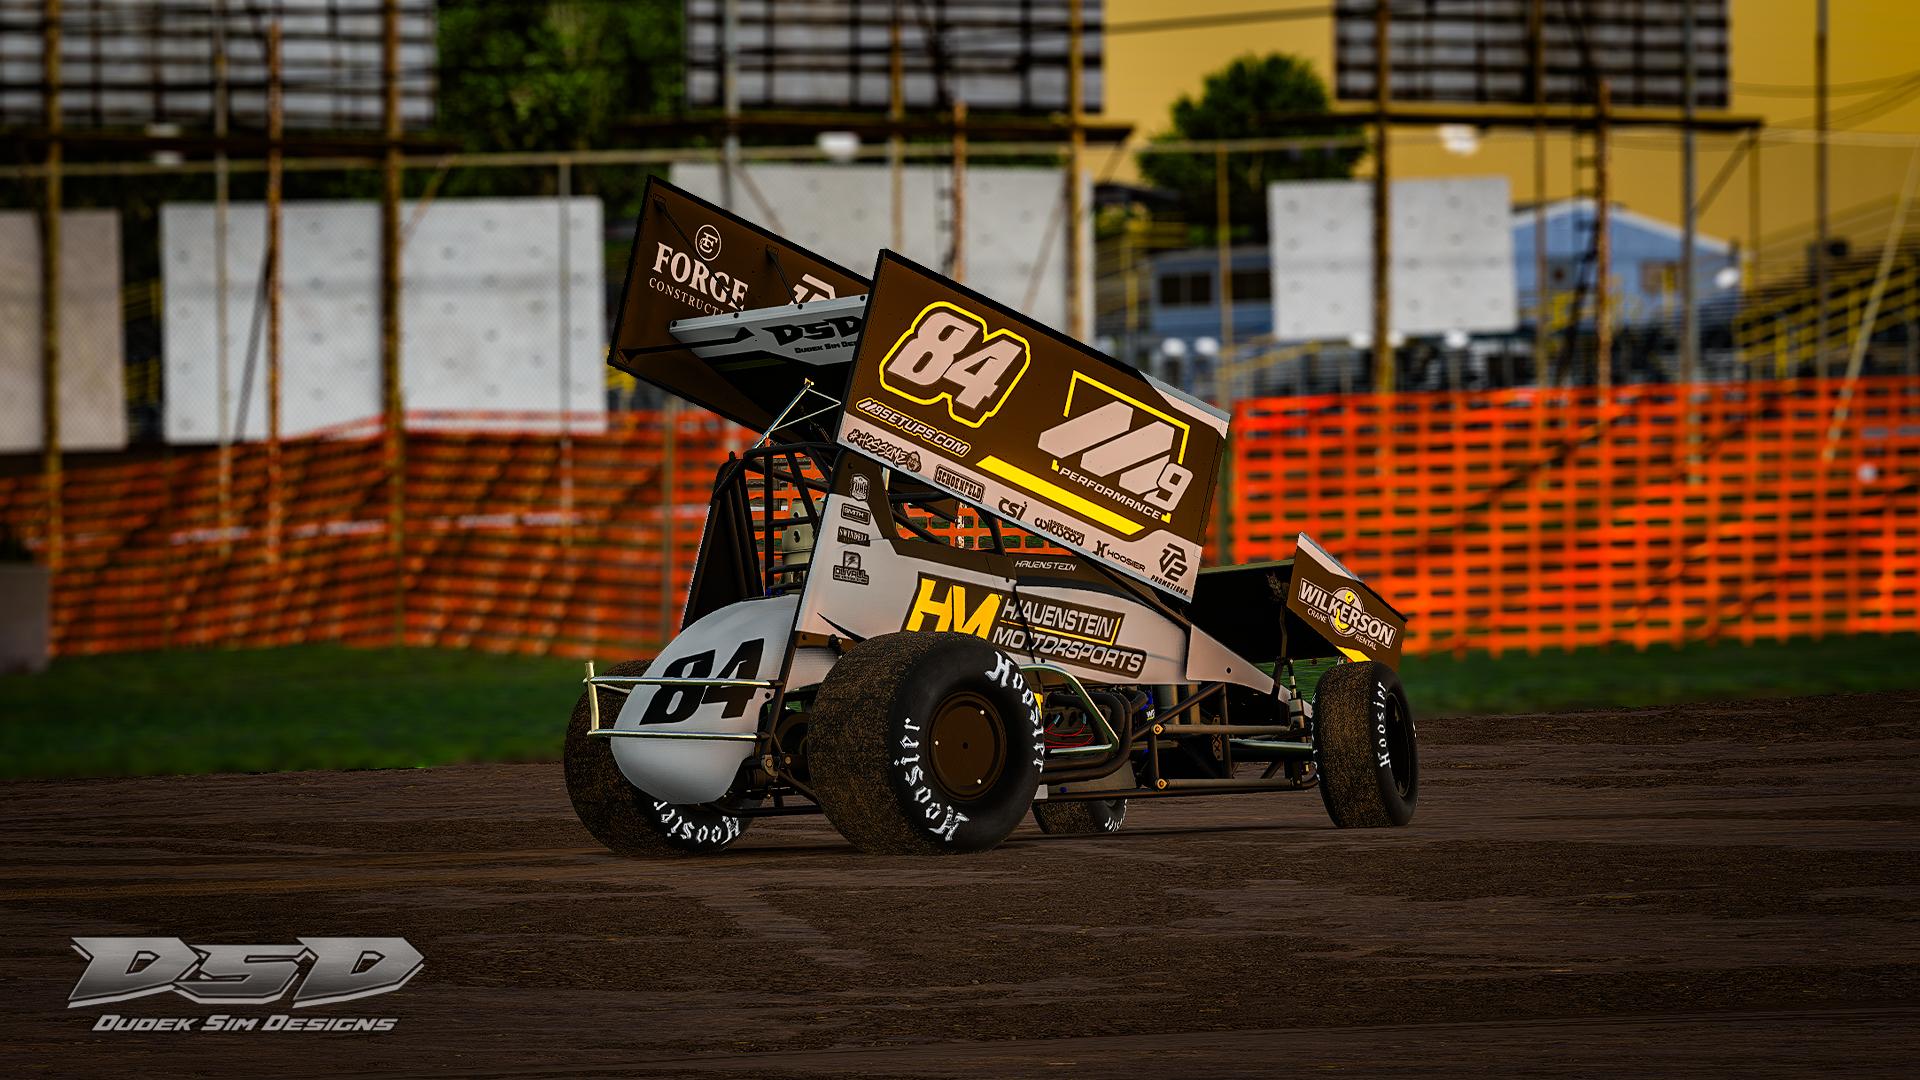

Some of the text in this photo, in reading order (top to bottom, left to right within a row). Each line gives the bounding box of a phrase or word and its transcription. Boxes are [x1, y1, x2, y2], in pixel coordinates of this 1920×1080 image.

[652, 241, 749, 312] FORGE
[761, 316, 862, 346] DSD
[887, 311, 1022, 409] 84
[937, 470, 981, 500] SCHOENFELD
[1059, 467, 1162, 520] PERFORMANCE
[1014, 560, 1077, 572] HAUENSTEIN
[1107, 549, 1146, 573] HOOSIER
[1150, 574, 1188, 596] PROMOTIONS
[906, 578, 1002, 639] HM
[1002, 598, 1116, 638] HAUENSTEIN
[1300, 581, 1394, 646] WILKERSON
[1307, 607, 1328, 624] CRANE
[993, 627, 1142, 672] MOTORSPORTS
[1355, 634, 1377, 651] RENTAL
[639, 638, 765, 725] 84
[1373, 682, 1391, 768] Hoosier
[894, 718, 970, 842] Hoosier
